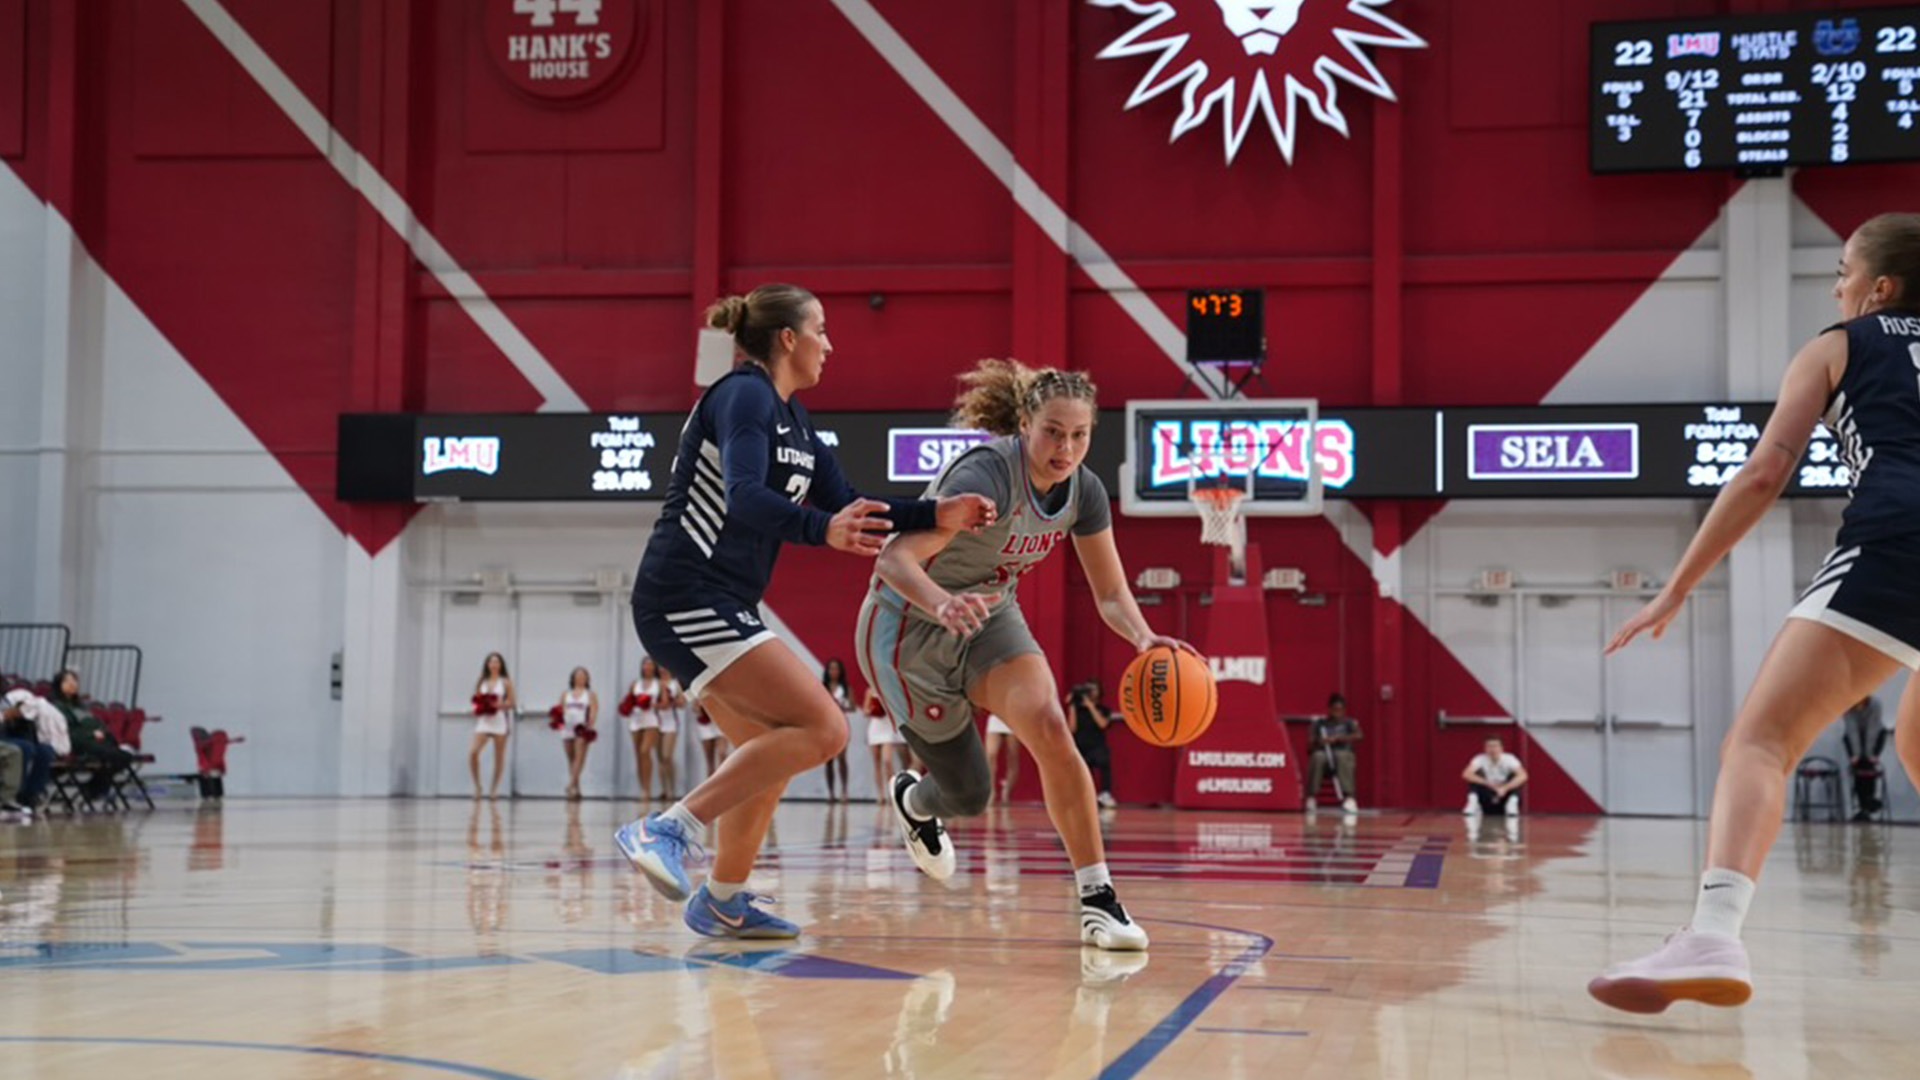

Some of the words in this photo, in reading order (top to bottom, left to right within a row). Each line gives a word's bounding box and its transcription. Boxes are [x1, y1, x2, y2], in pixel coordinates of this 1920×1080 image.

[508, 32, 612, 61] HANK'S
[1667, 32, 1720, 58] LMU
[1875, 26, 1917, 52] 22
[1614, 41, 1653, 66] 22
[529, 61, 590, 80] HOUSE
[1665, 68, 1719, 92] 9/12
[1811, 61, 1866, 85] 2/10
[1678, 89, 1708, 110] 21
[1826, 82, 1856, 103] 12
[1685, 109, 1702, 128] 7
[1831, 102, 1849, 122] 4
[1897, 112, 1914, 129] 4
[1617, 126, 1632, 142] 3
[1684, 128, 1702, 148] 0
[1831, 122, 1849, 142] 2
[1684, 148, 1702, 168] 6
[1831, 143, 1849, 162] 8
[423, 436, 500, 475] LMU
[1152, 419, 1355, 488] LIONS
[1500, 436, 1603, 468] SEIA
[1696, 441, 1748, 463] 8-22
[1209, 656, 1266, 685] LMU
[1151, 660, 1168, 723] Wilson
